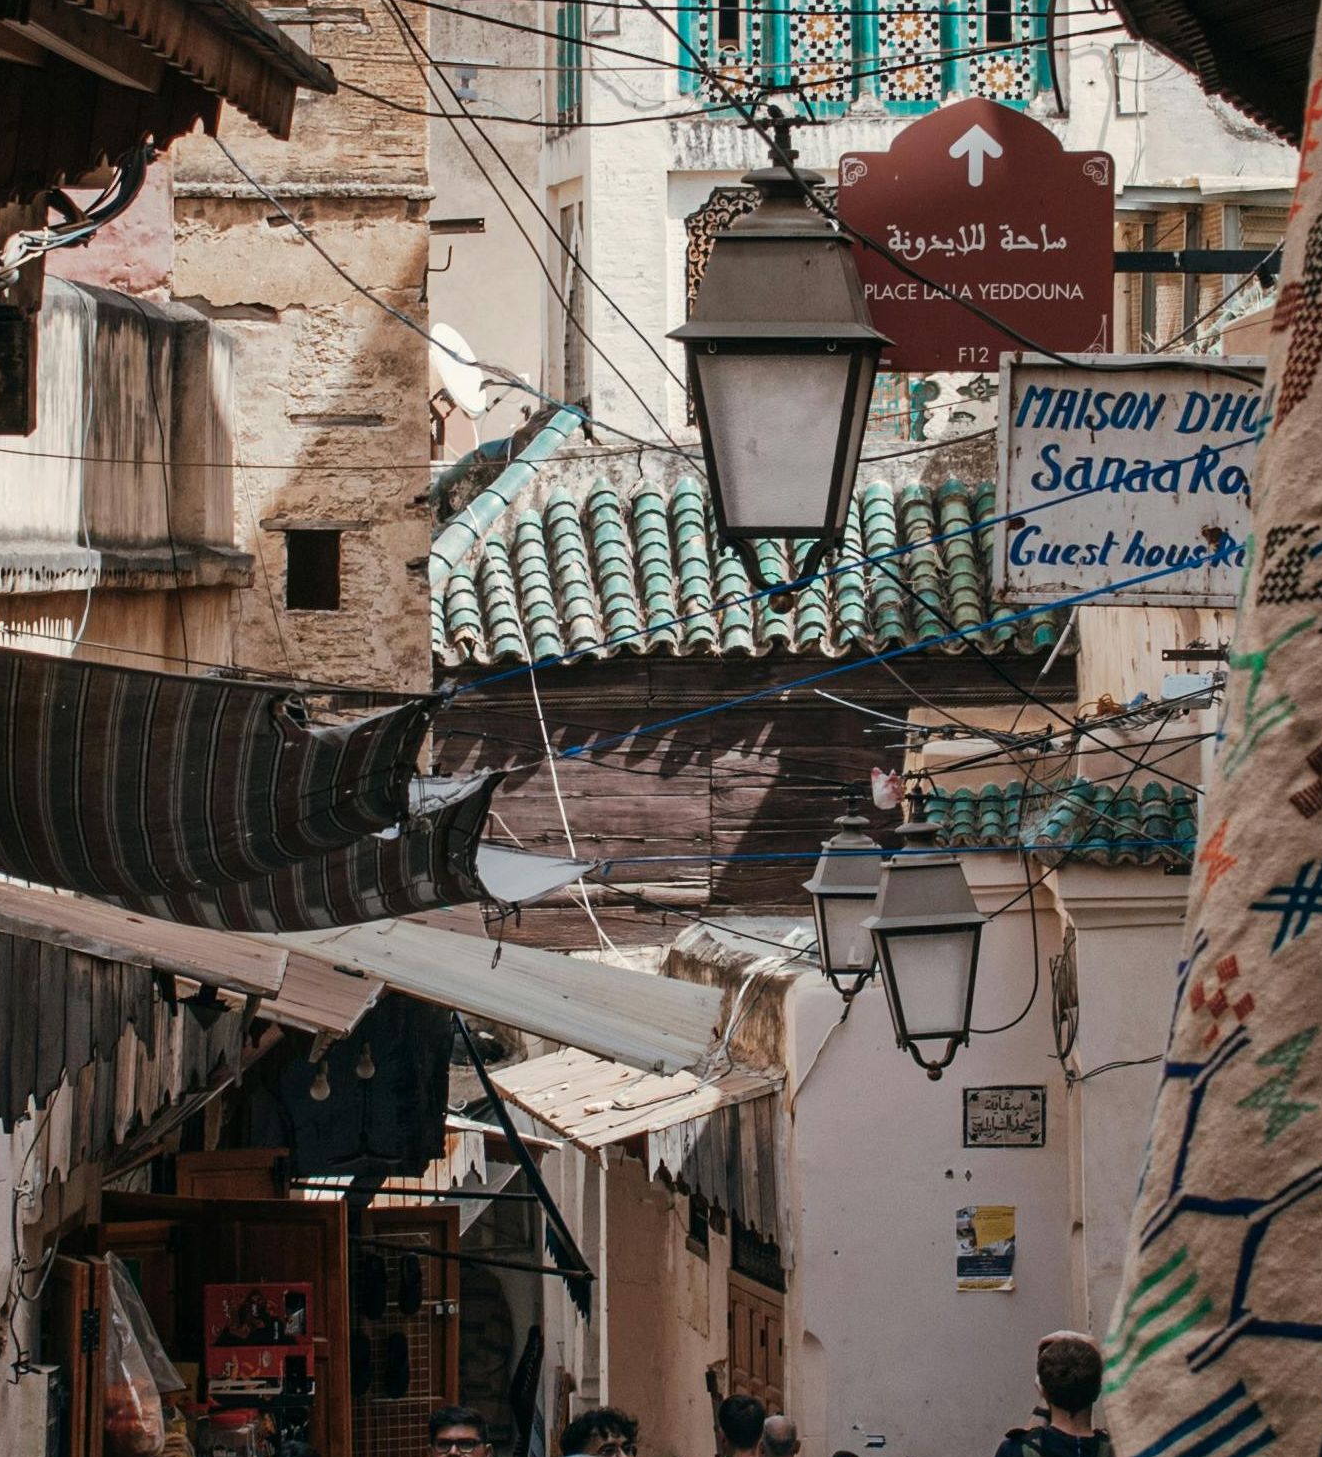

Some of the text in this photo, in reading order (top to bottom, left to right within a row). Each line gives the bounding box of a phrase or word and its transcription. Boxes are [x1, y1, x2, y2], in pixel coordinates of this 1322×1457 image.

[999, 223, 1067, 253] ساحة
[864, 283, 917, 300] PLACE
[978, 283, 1085, 300] YEDDOUNA
[958, 347, 989, 363] F12
[1015, 385, 1167, 432] MAISON
[1031, 444, 1183, 493] Sanaa
[1009, 525, 1119, 566] Guest
